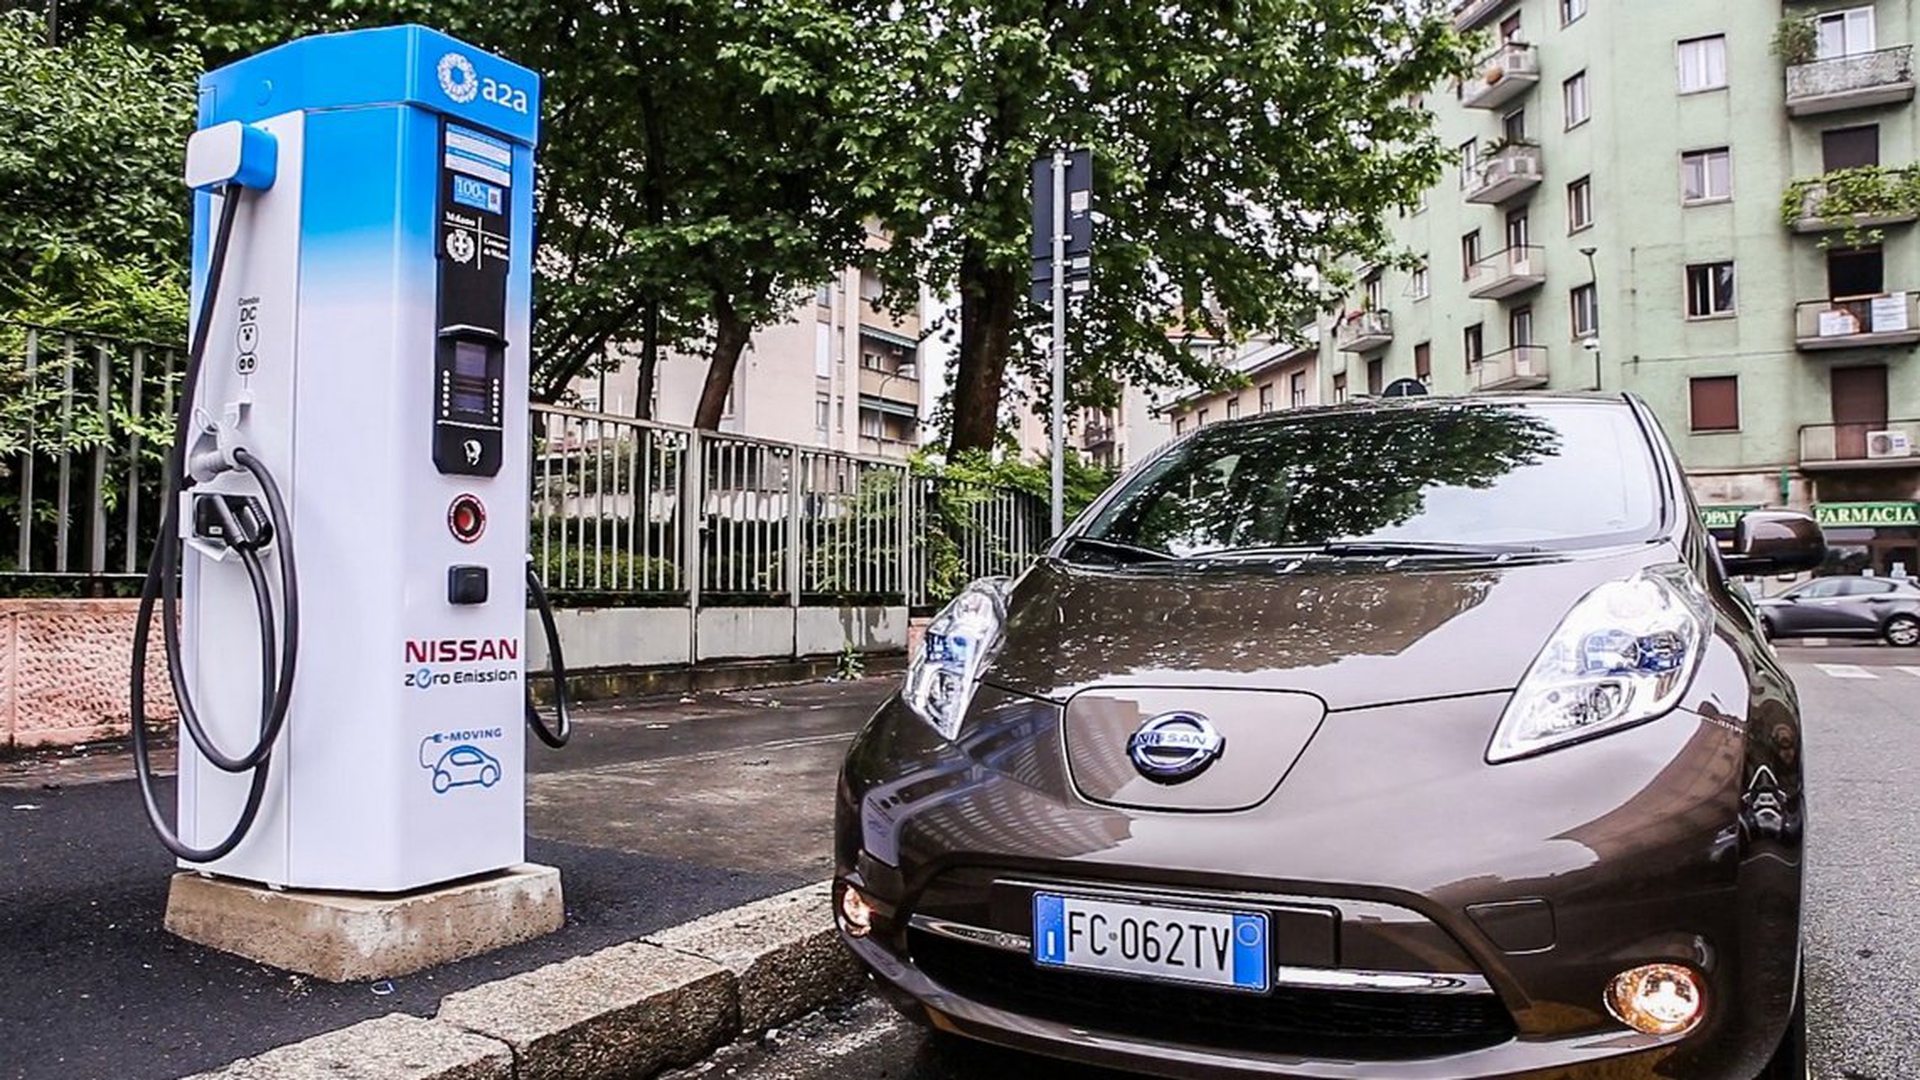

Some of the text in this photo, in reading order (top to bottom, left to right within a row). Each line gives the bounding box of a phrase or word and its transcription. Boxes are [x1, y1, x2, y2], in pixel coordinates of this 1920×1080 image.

[482, 77, 528, 114] a2a
[240, 306, 257, 322] DC
[1815, 507, 1916, 522] FARMACIA
[405, 639, 518, 663] NISSAN
[453, 669, 518, 684] Emission
[1139, 732, 1206, 745] NISSAN
